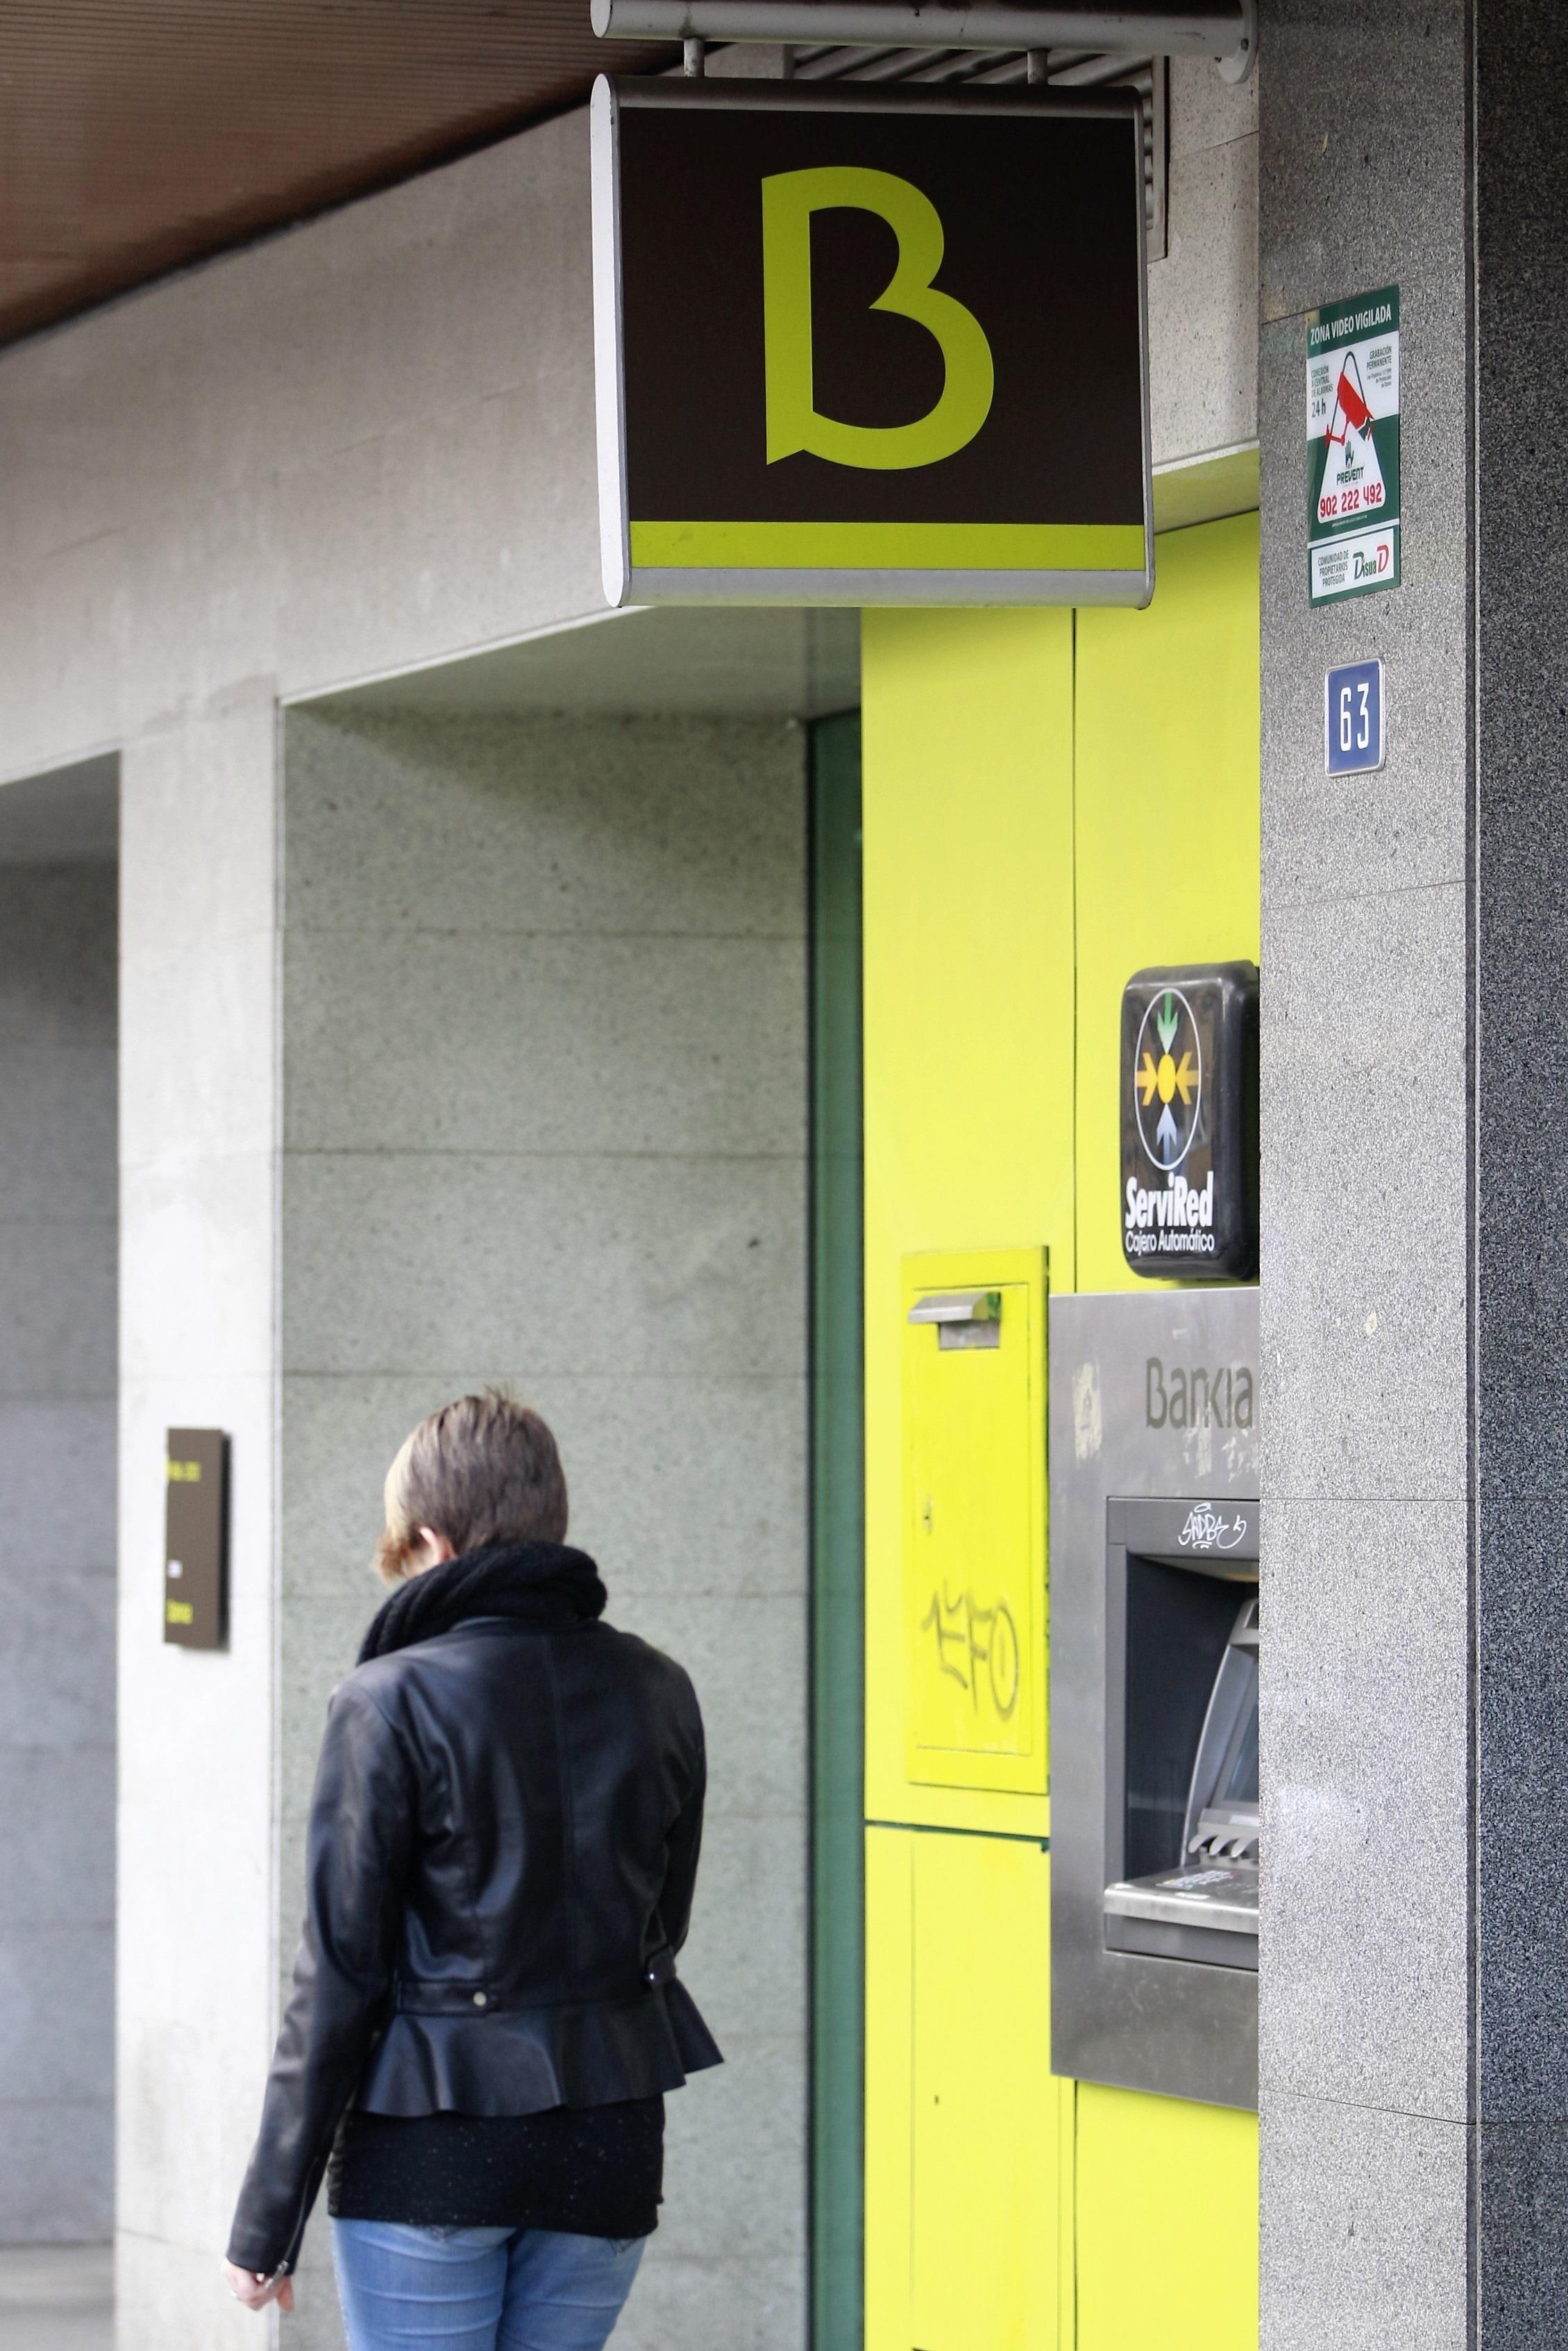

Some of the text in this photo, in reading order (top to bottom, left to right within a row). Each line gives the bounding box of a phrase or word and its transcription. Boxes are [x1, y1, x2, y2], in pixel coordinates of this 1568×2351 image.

[761, 165, 994, 471] B
[1310, 303, 1392, 346] ZONA VIDEO VIGILADA
[1369, 344, 1392, 360] GRABACIÓN
[1366, 355, 1392, 370] PERMANENTE
[1314, 375, 1329, 387] CENTRAL
[1316, 384, 1333, 396] ALARMAS
[1312, 397, 1326, 418] 24 h
[1336, 466, 1364, 485] PREVENT
[1320, 482, 1382, 518] 902 222 492
[1317, 550, 1349, 566] COMUNIDAD DE
[1319, 562, 1348, 578] PROPIETARIOS
[1322, 573, 1345, 588] PROTEGIDA
[1340, 682, 1369, 752] 63
[1125, 1170, 1214, 1229] ServiRed
[1125, 1228, 1215, 1256] Cajero Automático
[1146, 1356, 1253, 1429] Bankia
